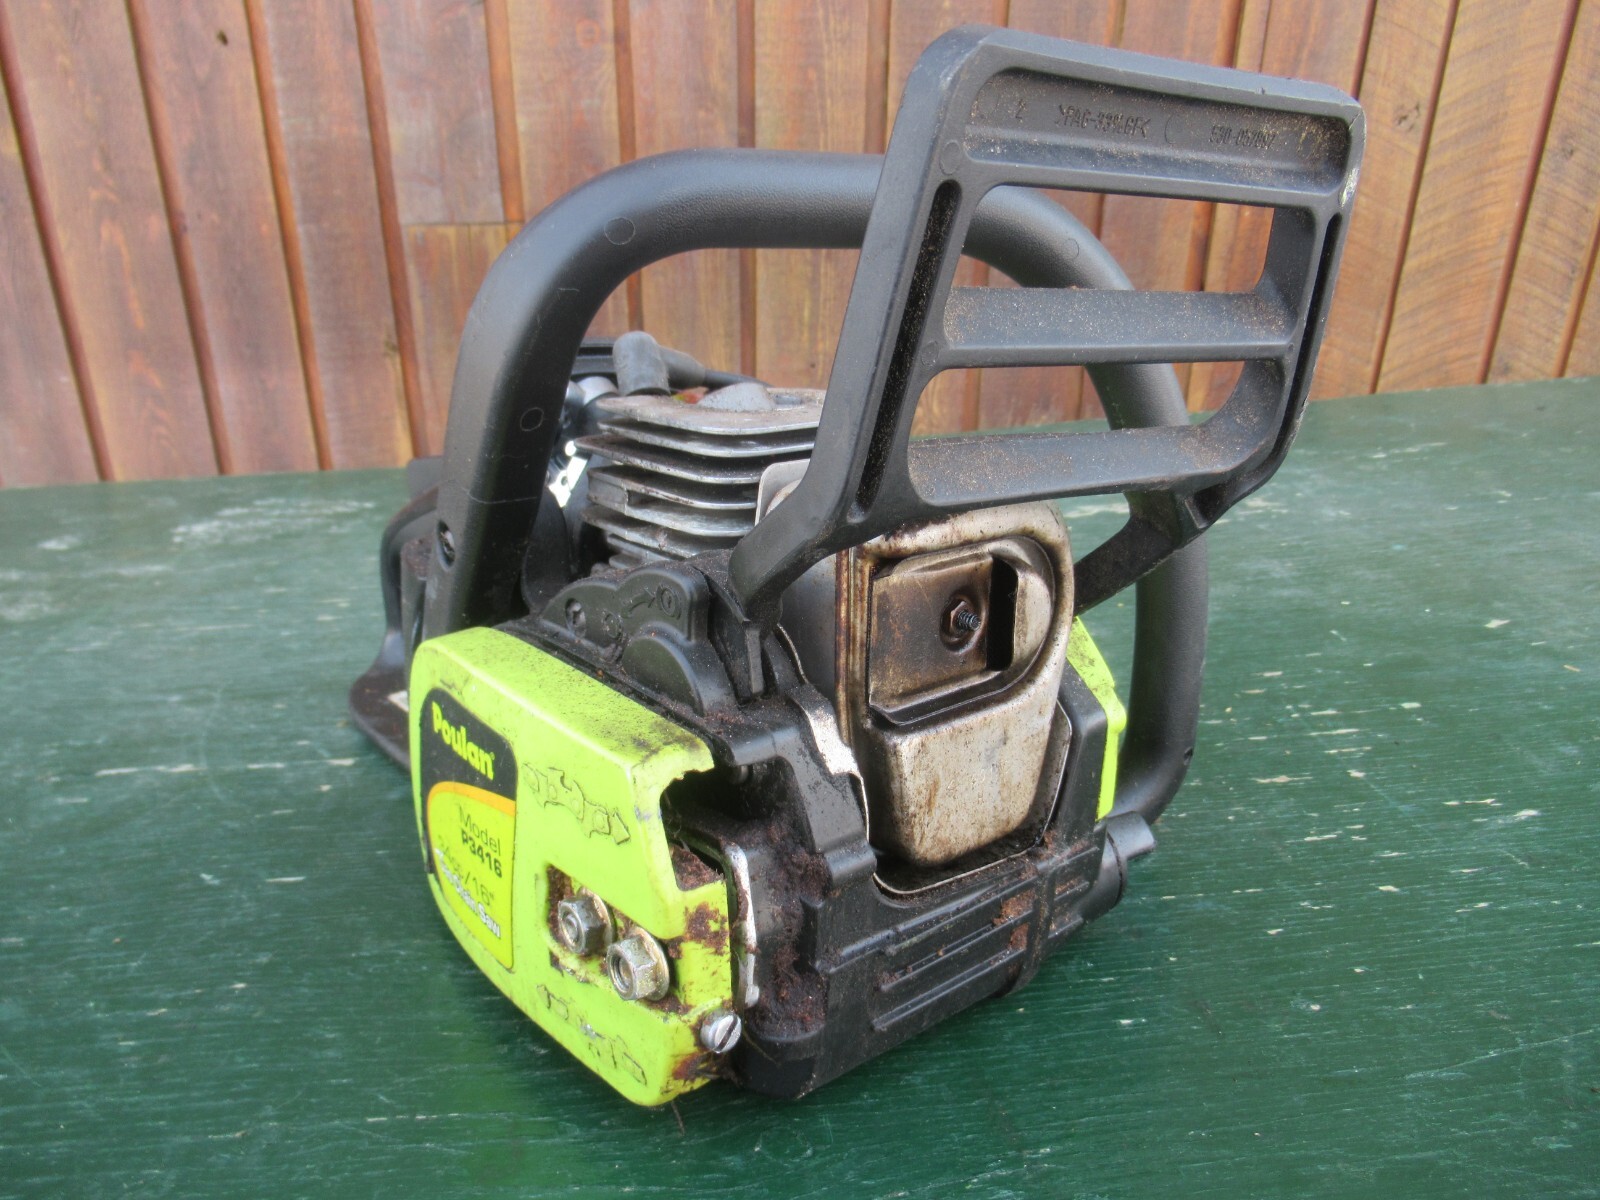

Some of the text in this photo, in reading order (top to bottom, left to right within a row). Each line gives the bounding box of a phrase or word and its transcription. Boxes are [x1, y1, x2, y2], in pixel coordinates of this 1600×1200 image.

[432, 701, 494, 780] Poulan
[457, 803, 501, 857] Model
[461, 828, 502, 879] P3416
[478, 901, 501, 940] Saw
